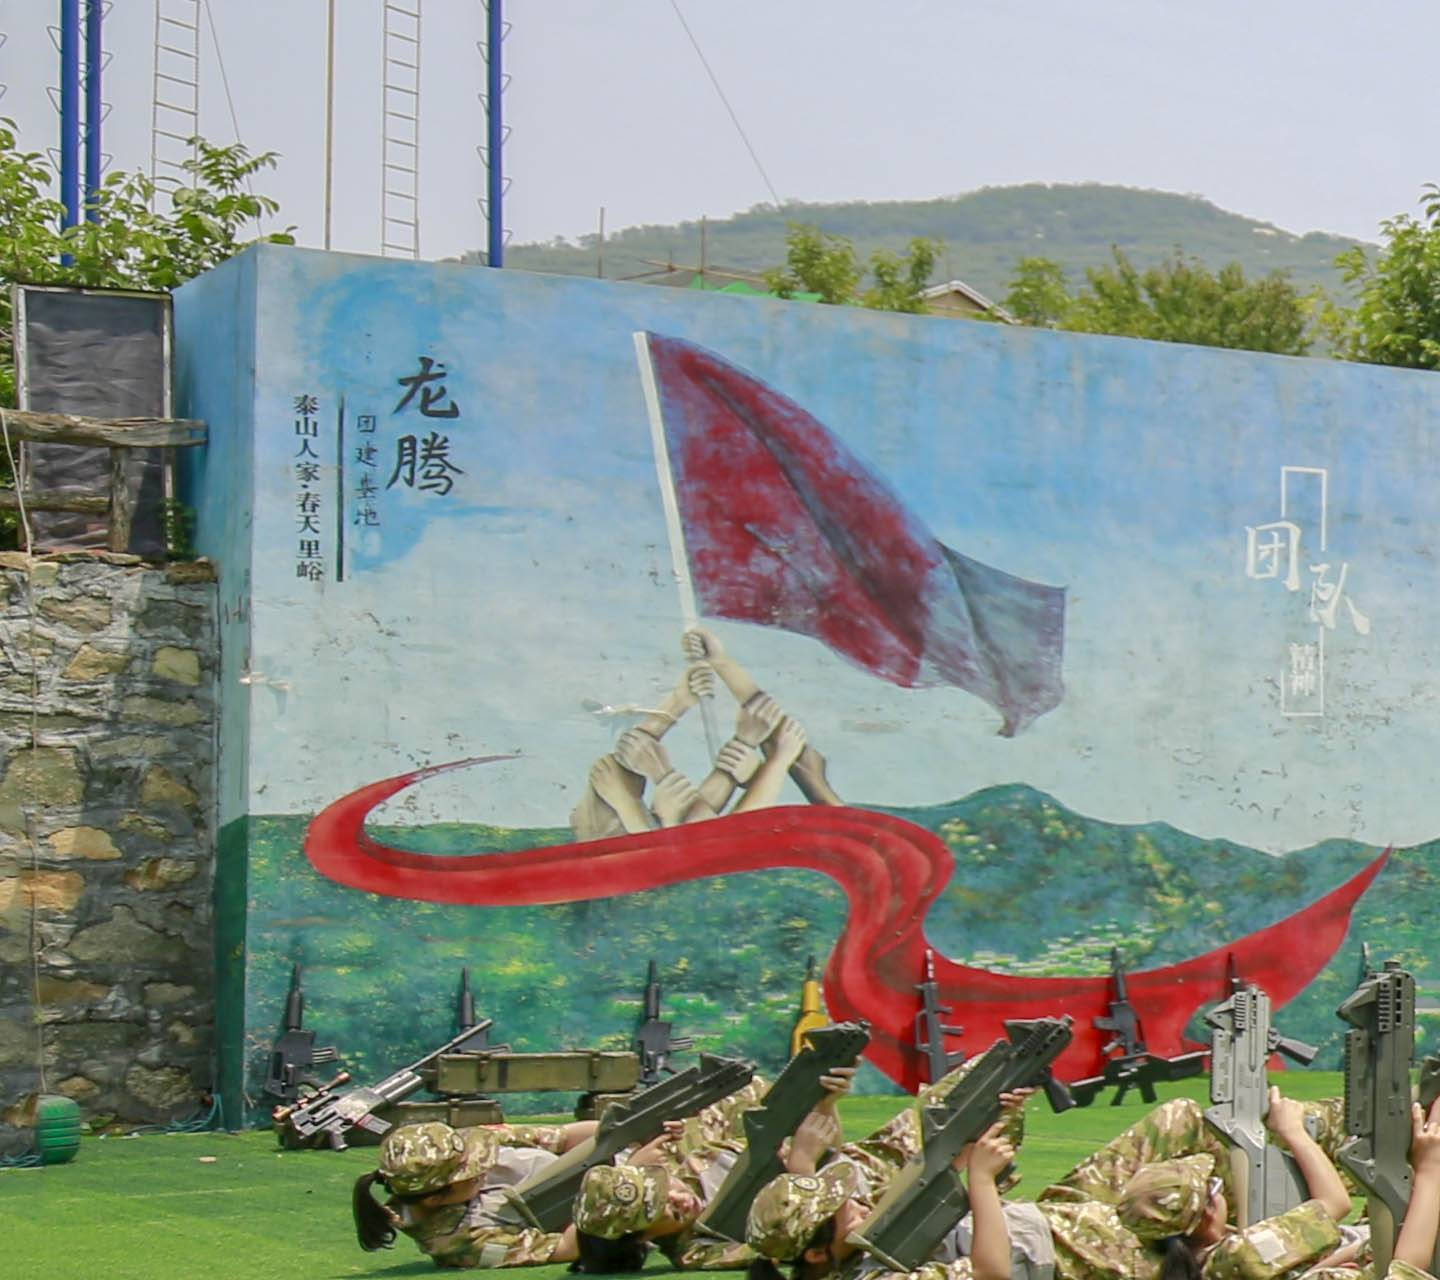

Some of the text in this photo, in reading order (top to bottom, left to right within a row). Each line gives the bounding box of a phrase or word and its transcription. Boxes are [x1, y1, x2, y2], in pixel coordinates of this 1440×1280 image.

[353, 414, 381, 528] 团建基地
[386, 356, 466, 497] 龙腾
